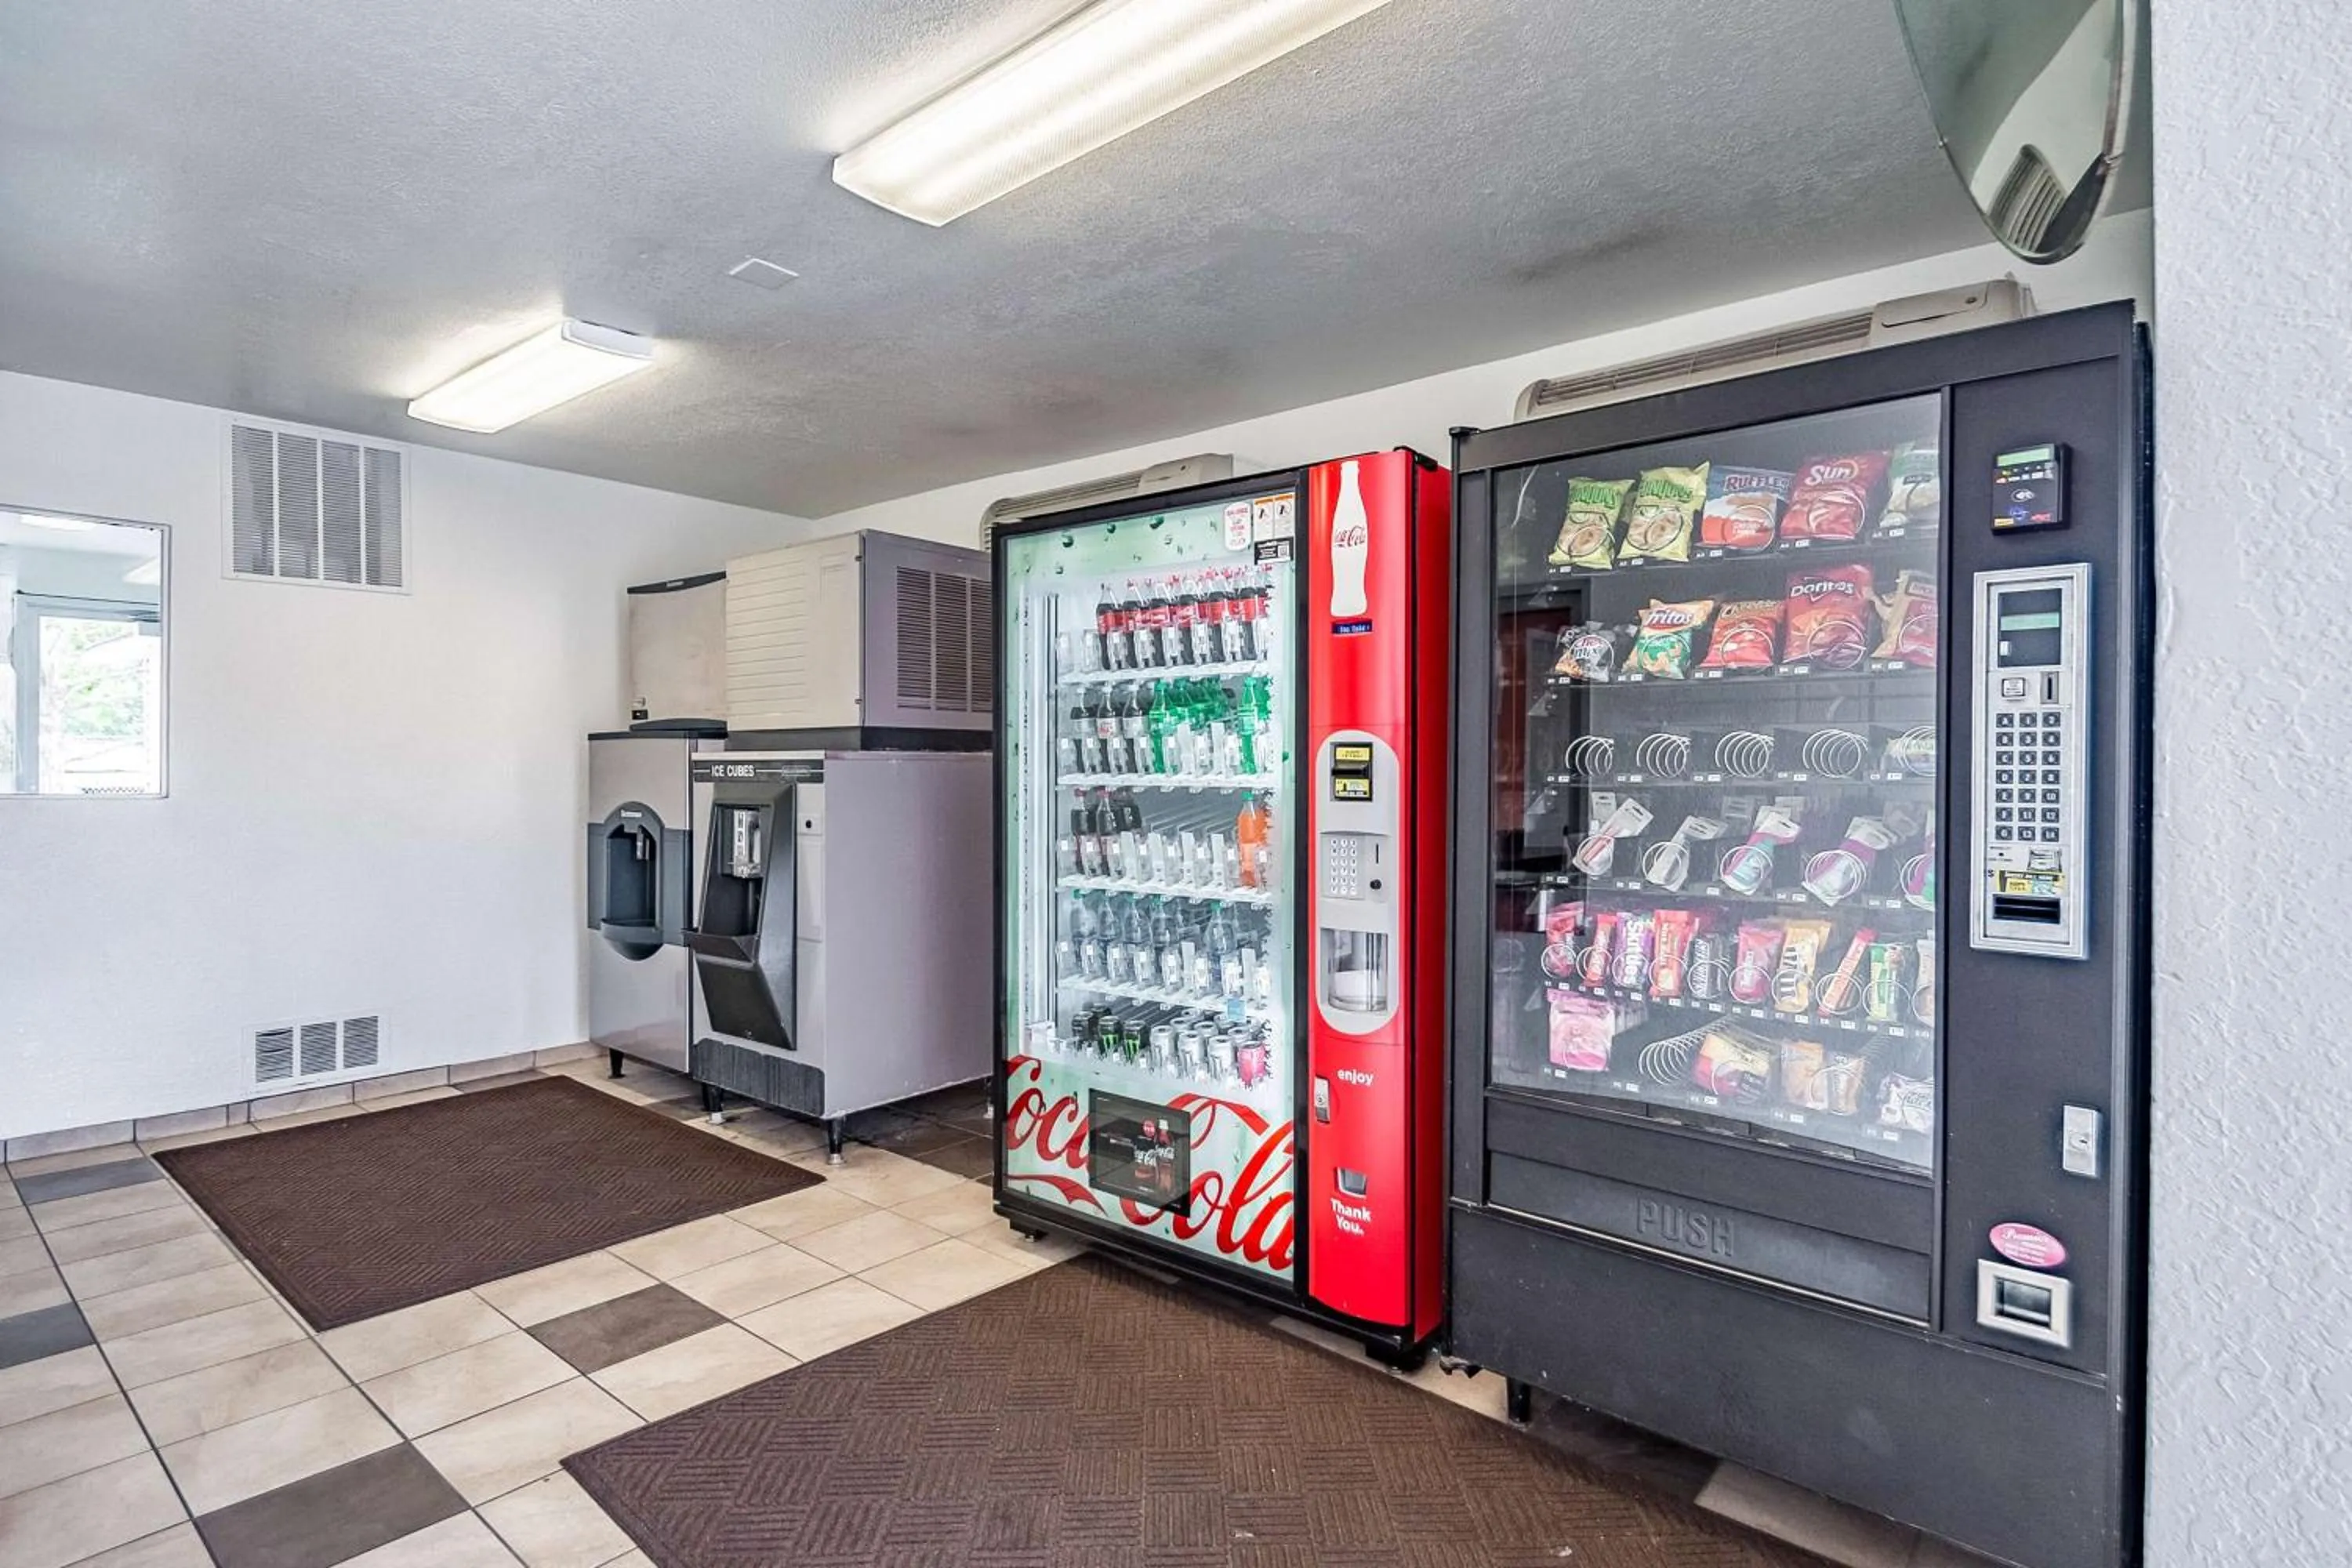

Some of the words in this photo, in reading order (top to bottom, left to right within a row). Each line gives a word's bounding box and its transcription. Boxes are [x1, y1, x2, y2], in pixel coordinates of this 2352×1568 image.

[1805, 464, 1852, 485] Sun
[1791, 580, 1855, 597] Doritos
[710, 764, 725, 777] ICE
[727, 764, 755, 777] CUBES
[1336, 1069, 1374, 1087] enjoy
[1330, 1197, 1372, 1222] Thank
[1636, 1196, 1734, 1258] PUSH
